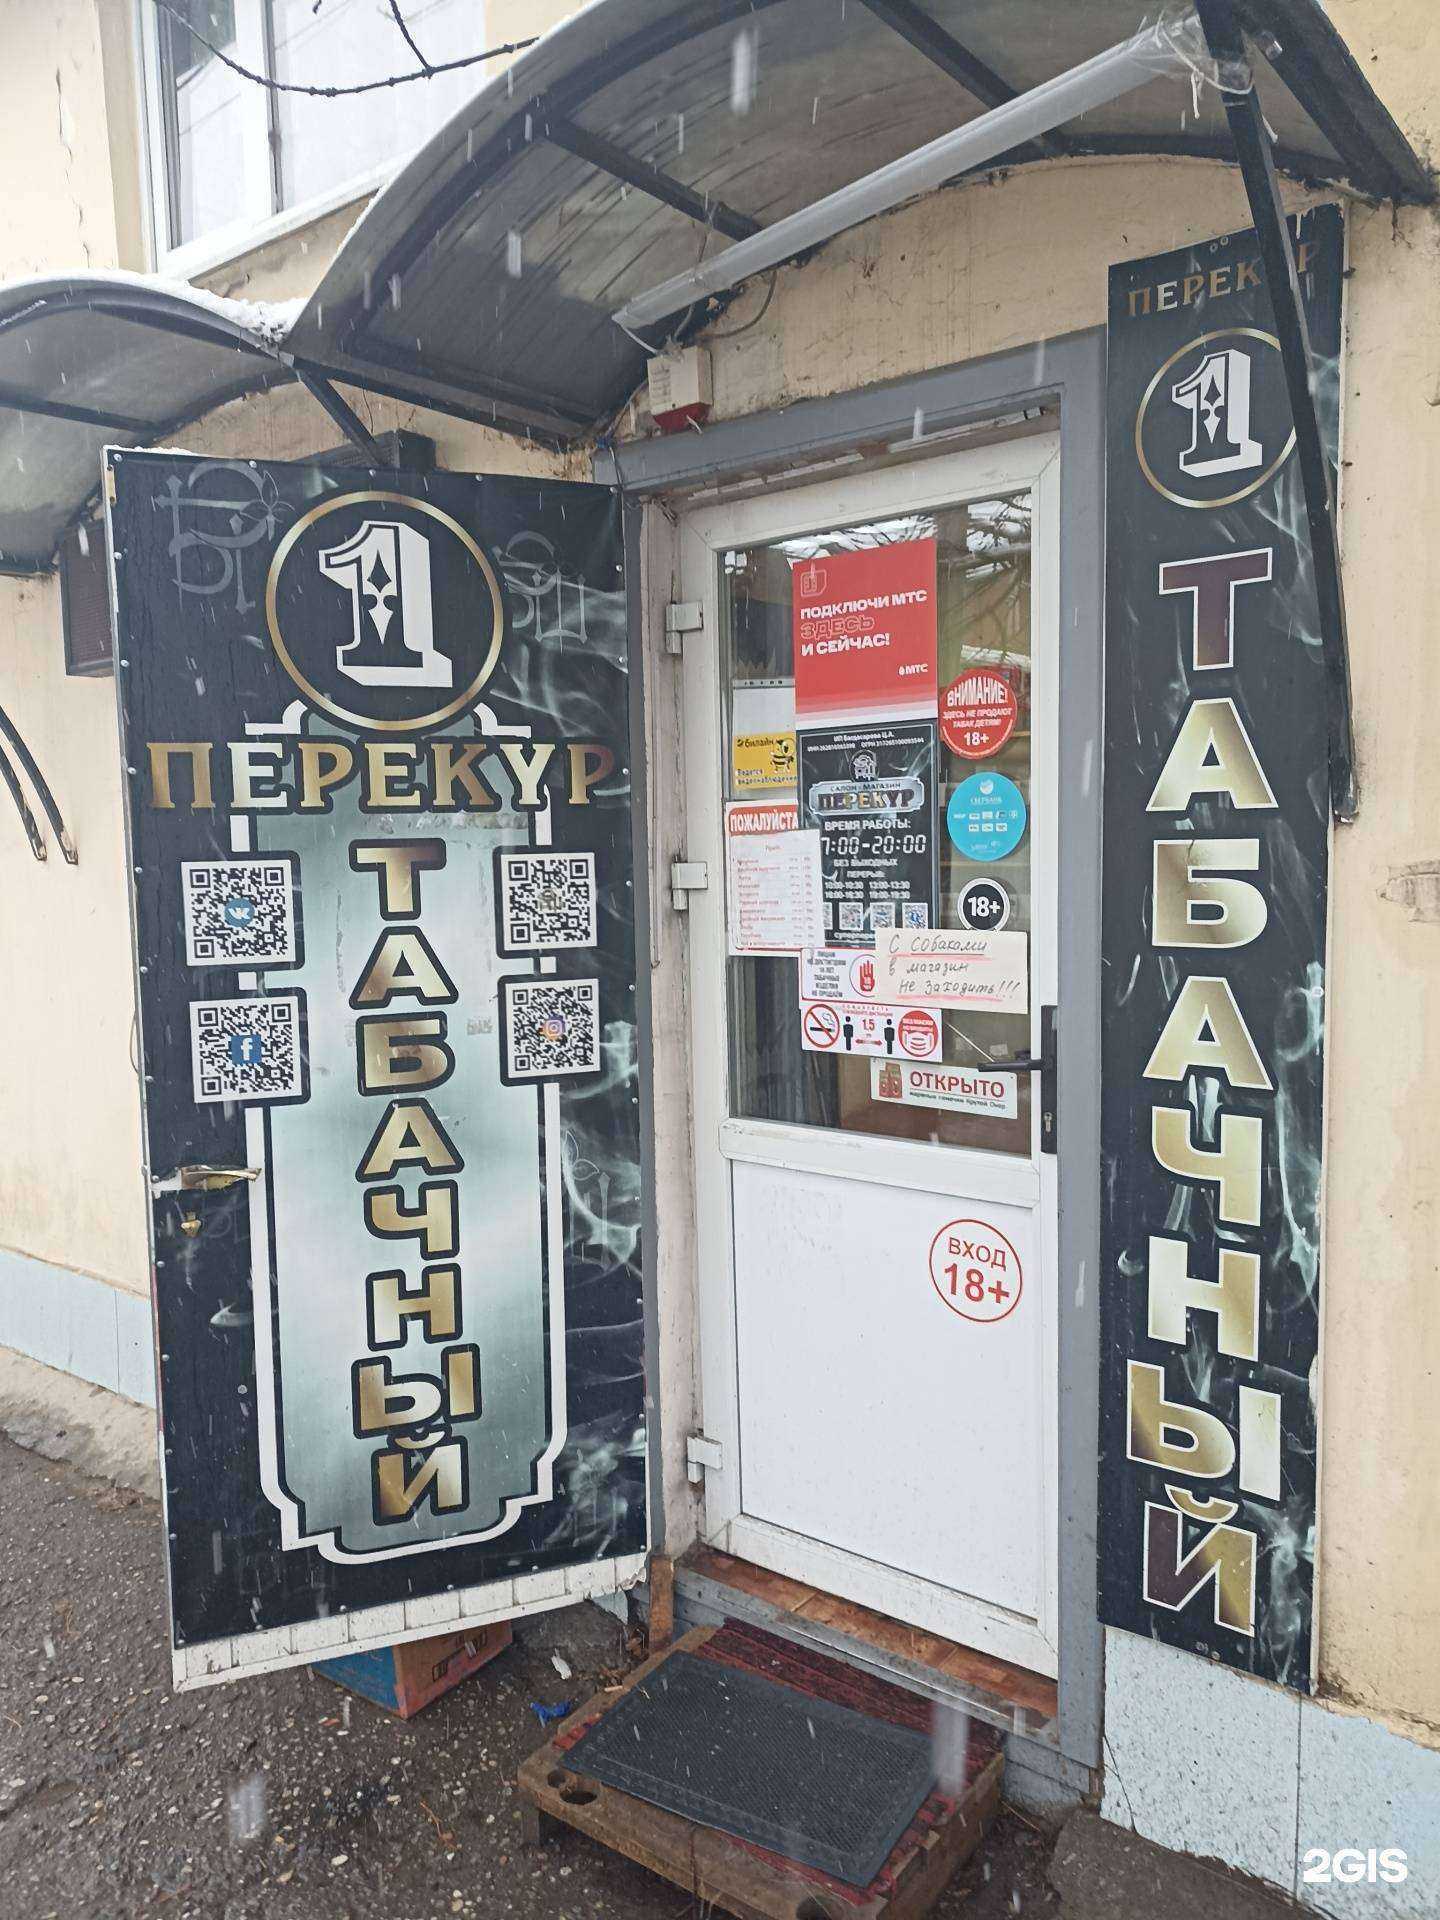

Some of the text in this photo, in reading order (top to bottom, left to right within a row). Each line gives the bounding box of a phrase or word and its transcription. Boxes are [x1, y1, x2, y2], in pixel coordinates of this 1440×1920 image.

[1127, 242, 1318, 318] ПЕРЕКР
[1171, 349, 1263, 478] 1
[318, 520, 453, 688] 1
[800, 589, 928, 619] ПОДКЛЮЧИ МТС
[800, 615, 875, 640] ЗДЕСЬ
[801, 633, 891, 656] И СЕЙЧАС!
[905, 664, 928, 674] МТС
[946, 676, 1009, 707] ВНИМАНИЕ!
[963, 731, 990, 746] 18+
[146, 741, 614, 809] ПЕРЕКУР
[818, 789, 915, 810] ПЕРЕКУР
[730, 809, 799, 832] ПОЖАЛУЙСТА
[824, 818, 911, 831] ВРЕМЯ РАБОТЫ:
[967, 896, 1001, 917] 18+
[906, 961, 969, 976] магазин
[909, 1071, 1005, 1098] ОТКРЫТО
[1126, 547, 1281, 1637] ТАБАЧНЫЙ
[354, 845, 477, 1521] ТАБАЧНЫЙ
[948, 1236, 1007, 1272] ВХОД
[944, 1262, 1010, 1304] 18+
